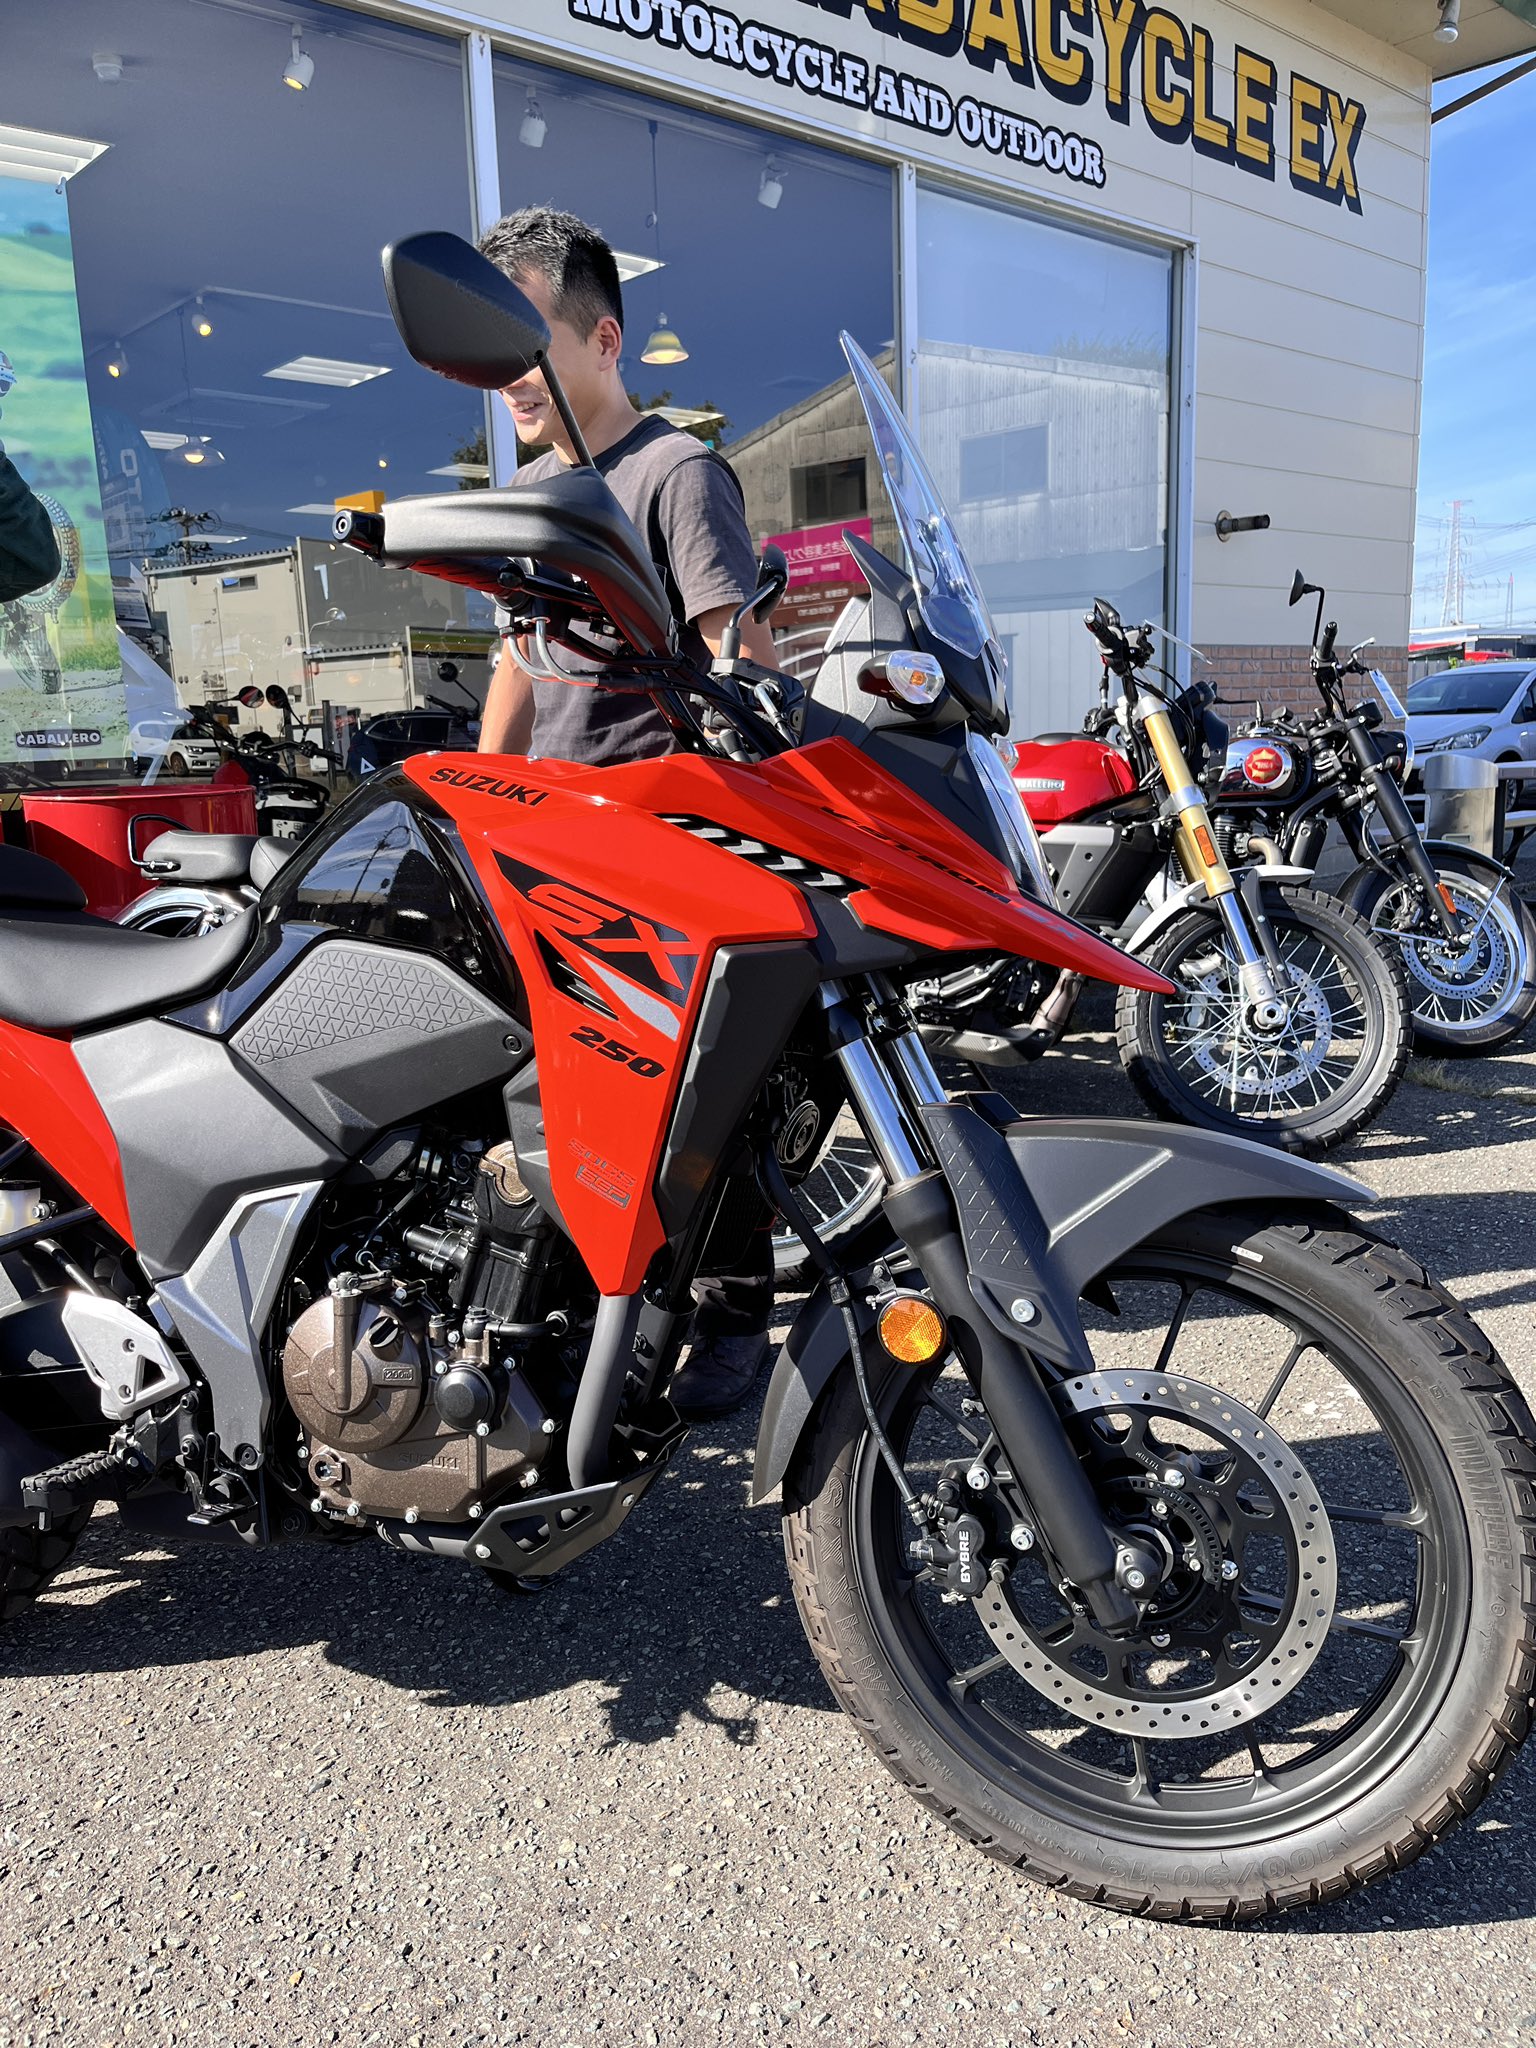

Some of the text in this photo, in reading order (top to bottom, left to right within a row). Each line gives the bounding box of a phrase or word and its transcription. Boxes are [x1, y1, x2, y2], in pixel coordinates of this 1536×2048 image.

[873, 75, 952, 132] AND
[958, 101, 1104, 185] OUTDOOR
[1290, 73, 1365, 214] EX
[16, 732, 101, 746] CABALLERO
[428, 767, 550, 807] SUZUKI
[527, 883, 701, 991] SX
[568, 1025, 667, 1079] 250
[400, 1452, 460, 1470] SUZUKI
[818, 1475, 891, 1693] MAXXIS
[959, 1531, 971, 1583] BYBRE
